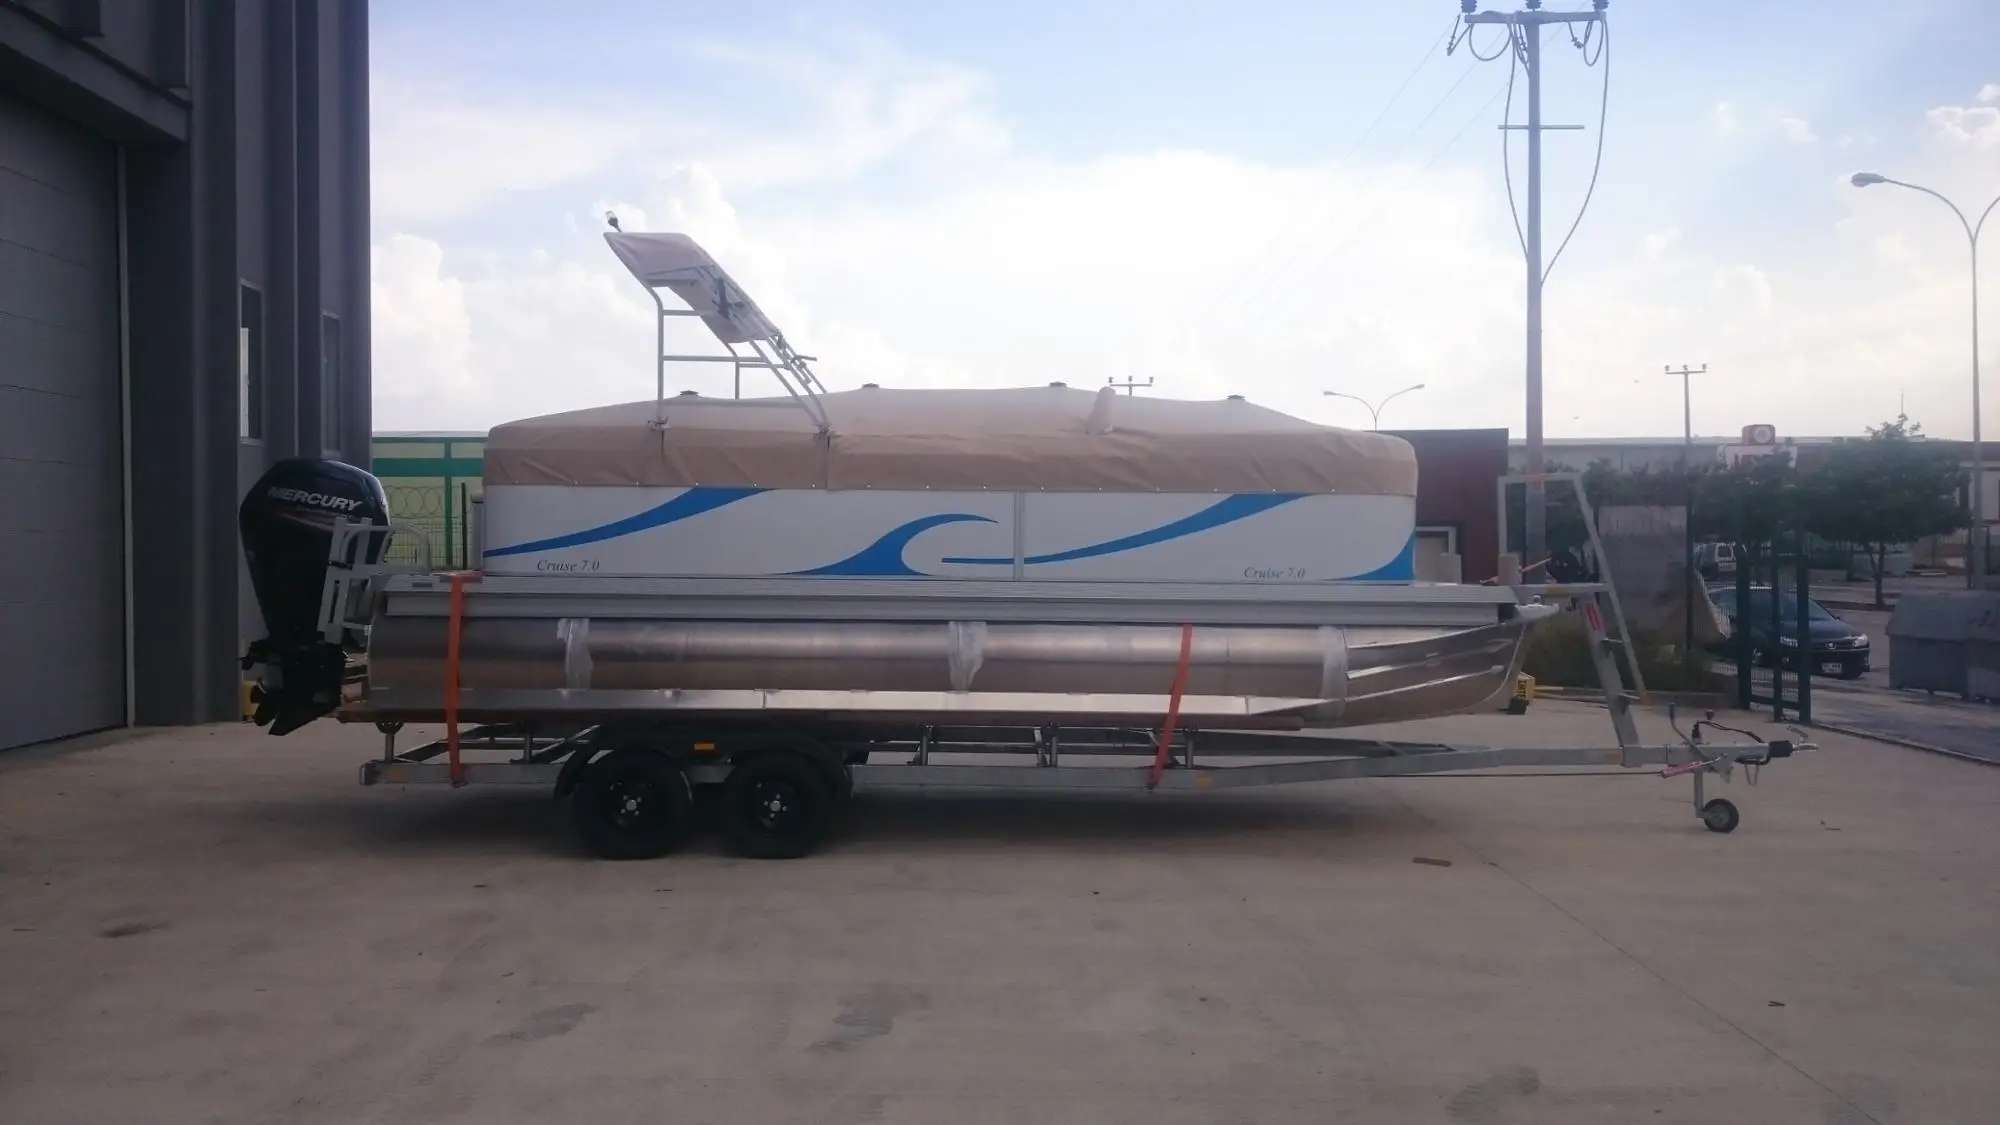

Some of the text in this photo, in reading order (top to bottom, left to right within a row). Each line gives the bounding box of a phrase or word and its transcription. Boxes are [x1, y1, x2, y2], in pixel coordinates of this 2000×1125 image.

[267, 486, 362, 511] MERCURY
[536, 559, 600, 571] Cruise 7.0
[1244, 566, 1306, 578] Cruise 7.0
